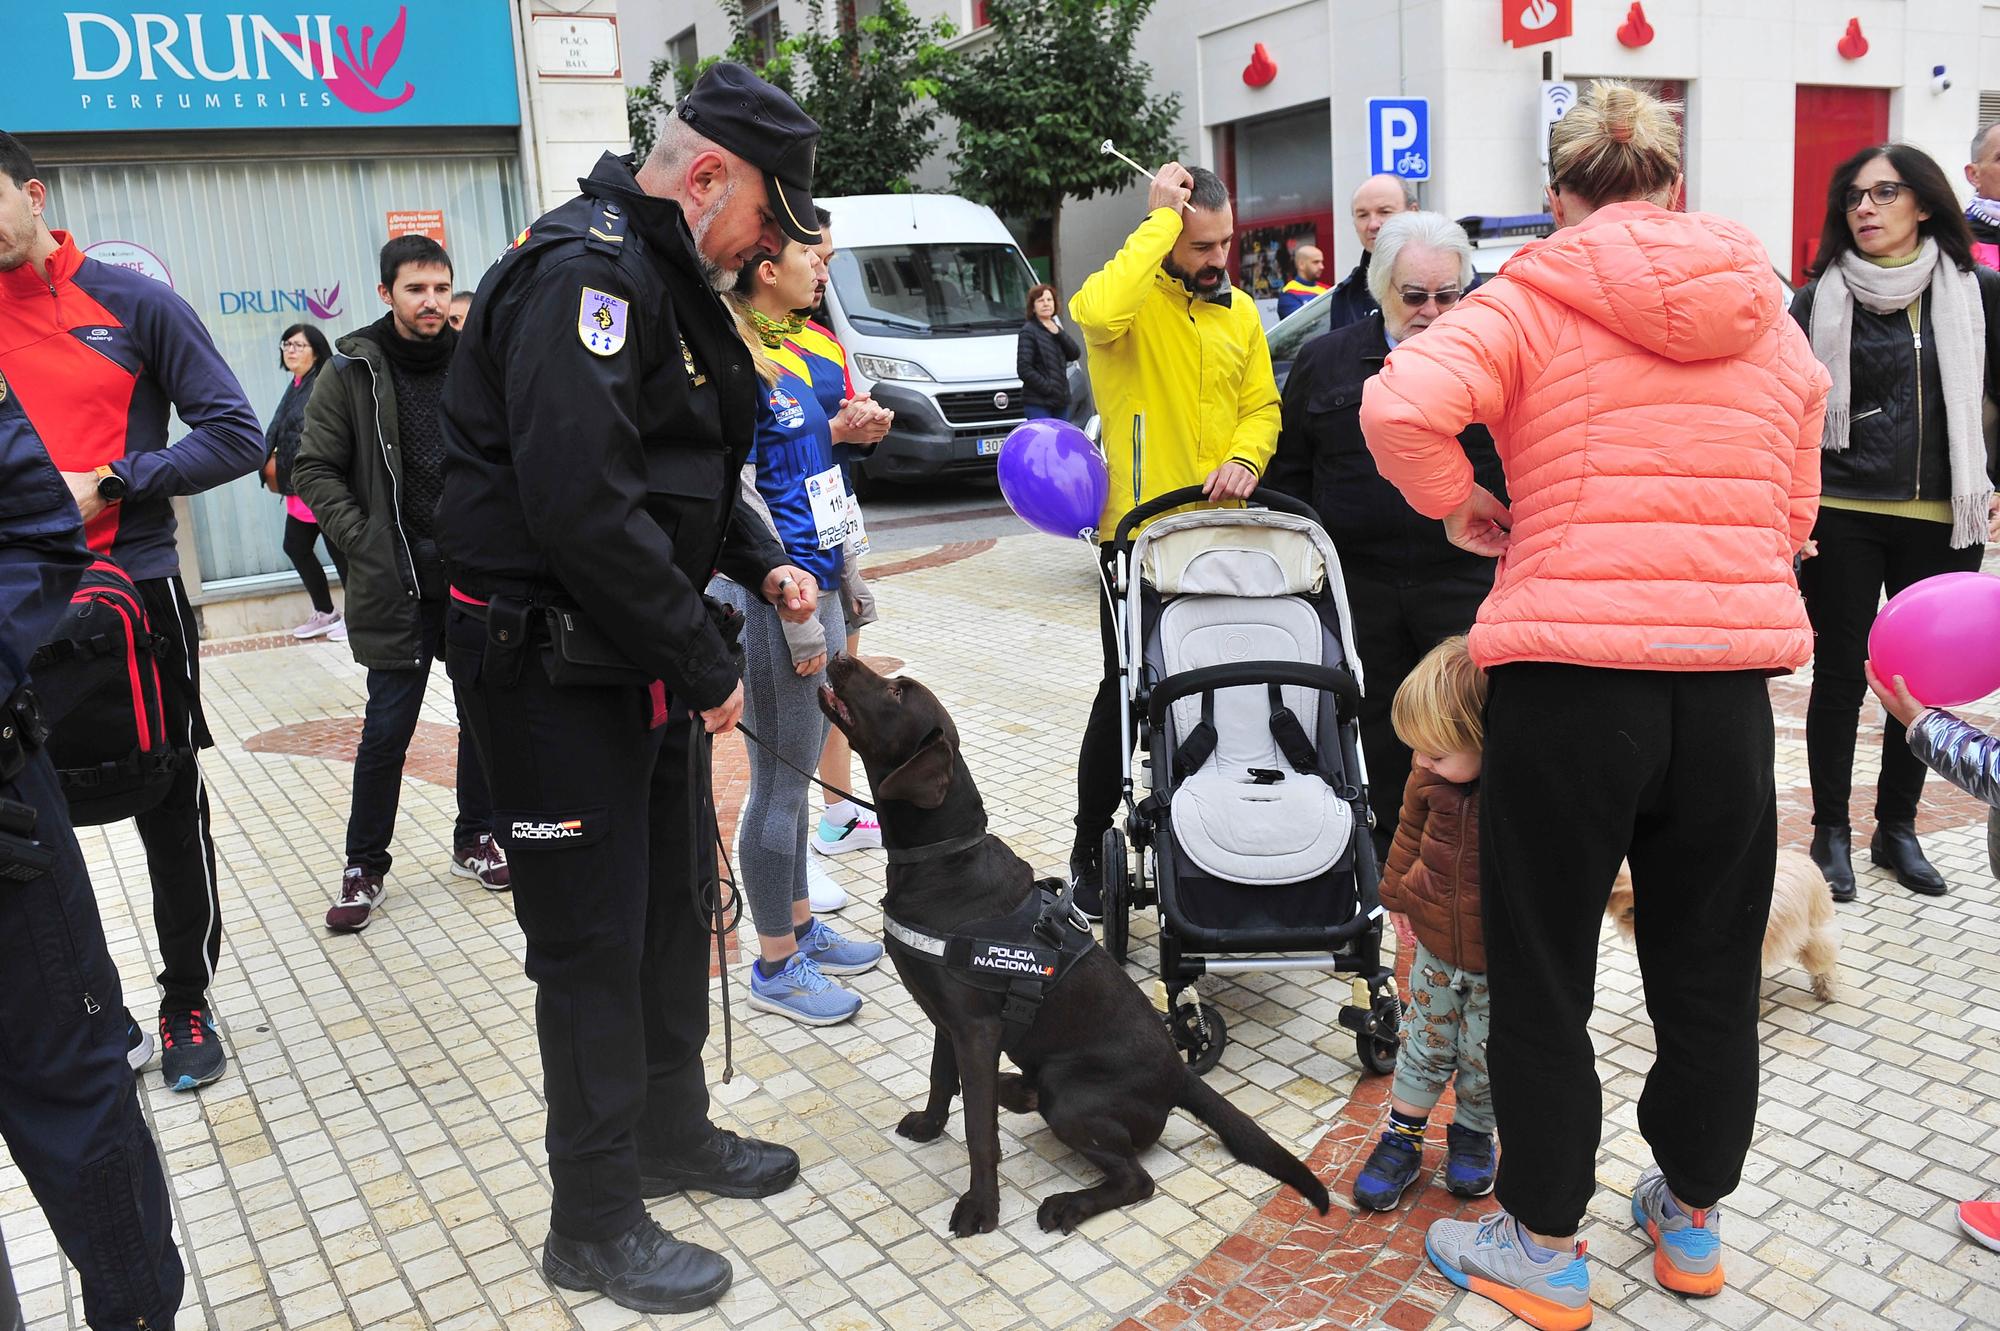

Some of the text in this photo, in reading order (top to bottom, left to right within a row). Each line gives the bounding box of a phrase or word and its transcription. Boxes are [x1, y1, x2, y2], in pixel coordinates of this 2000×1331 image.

[63, 12, 339, 81] DRUNI
[569, 49, 581, 57] DE
[565, 60, 588, 68] BAIX
[81, 92, 332, 109] PERFUMERIES
[1381, 107, 1418, 172] P
[219, 288, 308, 314] DRUNI
[512, 822, 564, 831] POLICIA
[512, 829, 582, 839] NACIONAL
[988, 946, 1036, 962] POLICIA
[973, 956, 1047, 975] NACIONAL
